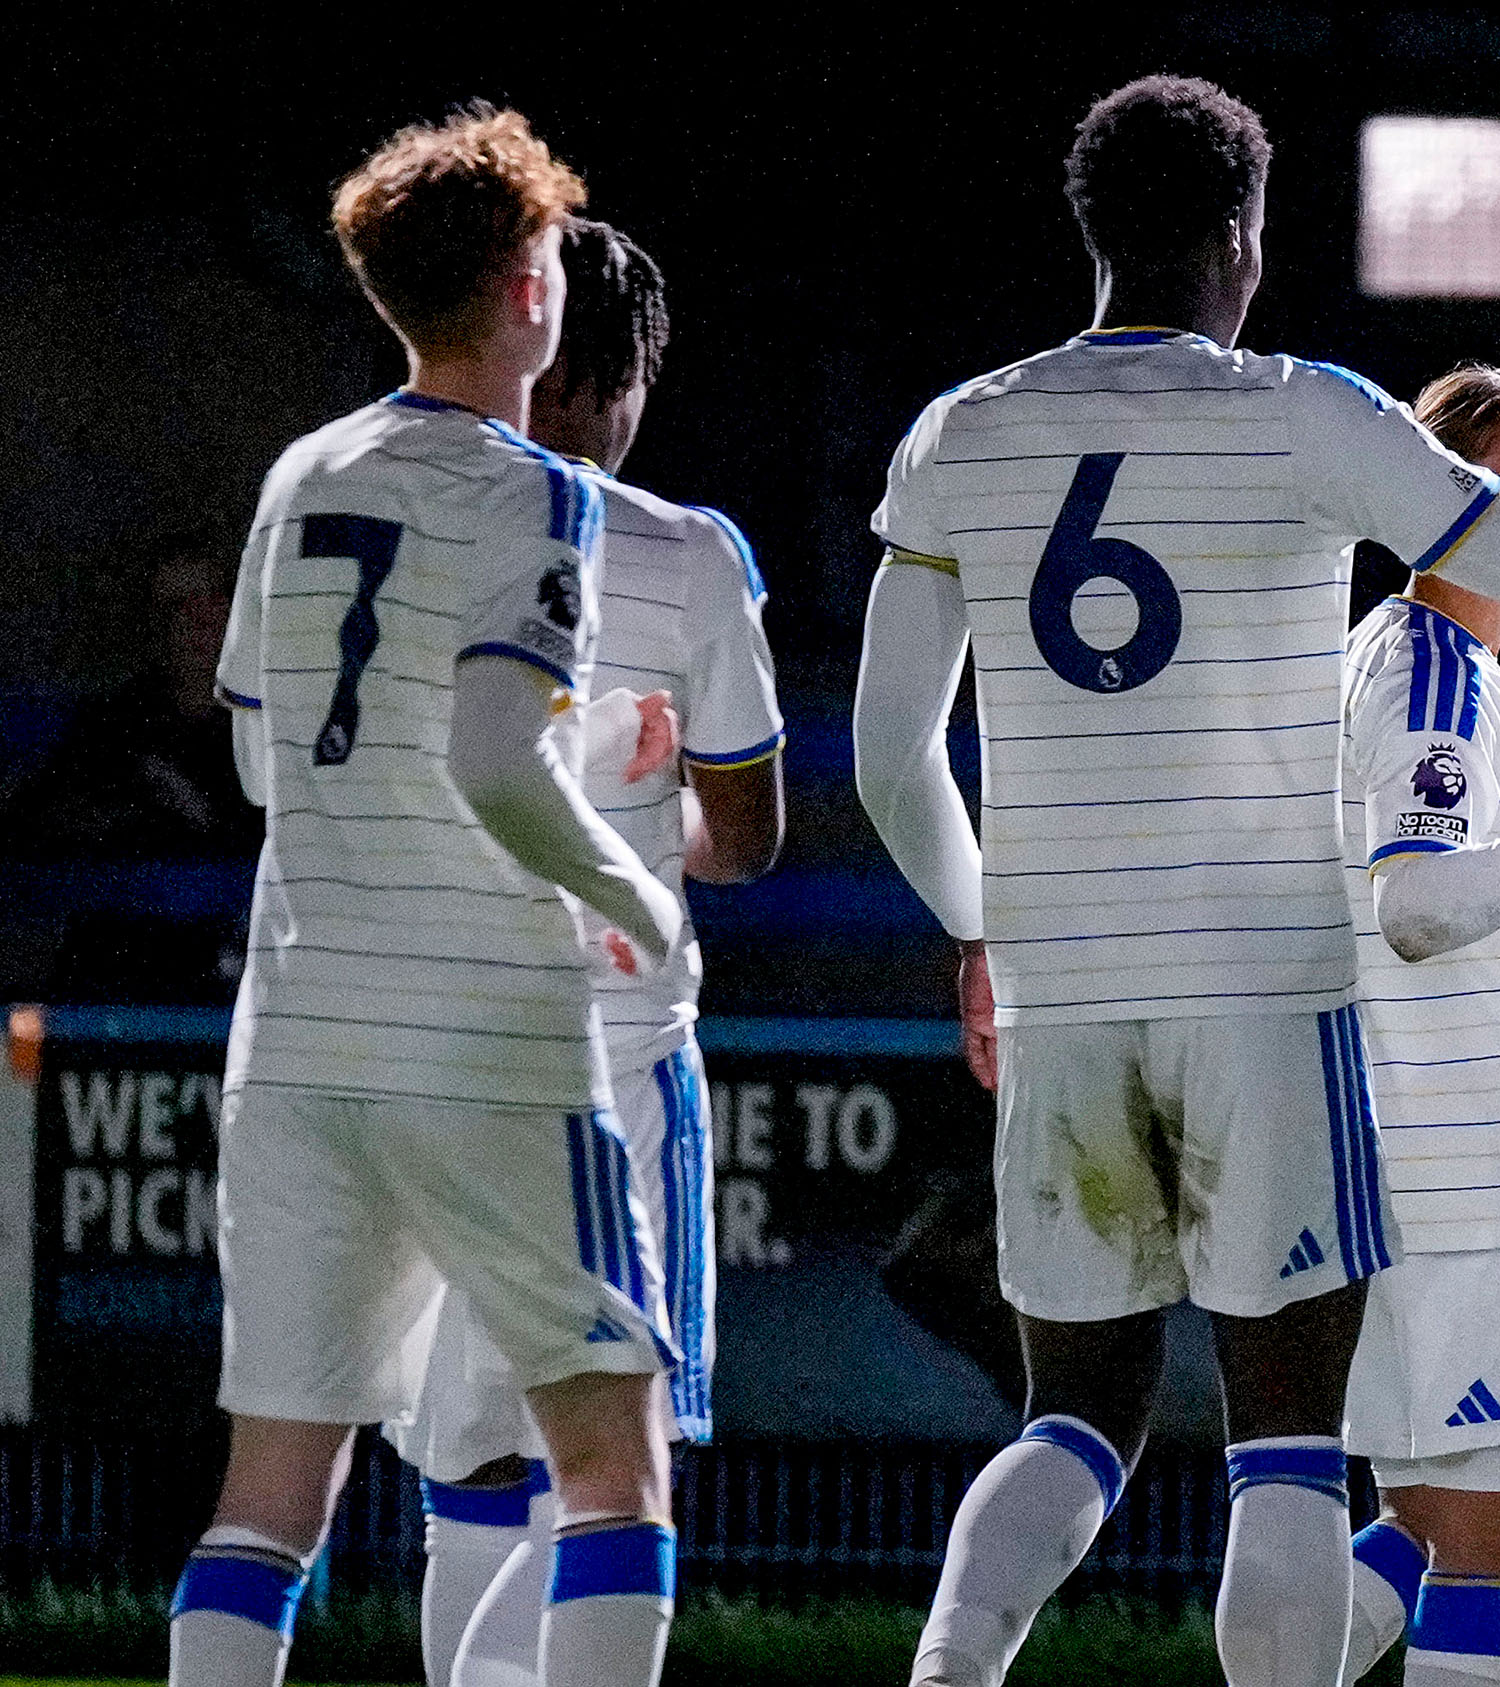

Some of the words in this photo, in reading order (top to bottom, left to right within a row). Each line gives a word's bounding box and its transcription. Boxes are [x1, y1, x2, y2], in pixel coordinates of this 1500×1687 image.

[1028, 452, 1182, 694] 6
[300, 512, 404, 766] 7
[1397, 813, 1419, 827] No
[1421, 814, 1463, 831] room
[1419, 825, 1466, 844] racism
[795, 1083, 898, 1174] TO
[720, 1179, 792, 1269] R.
